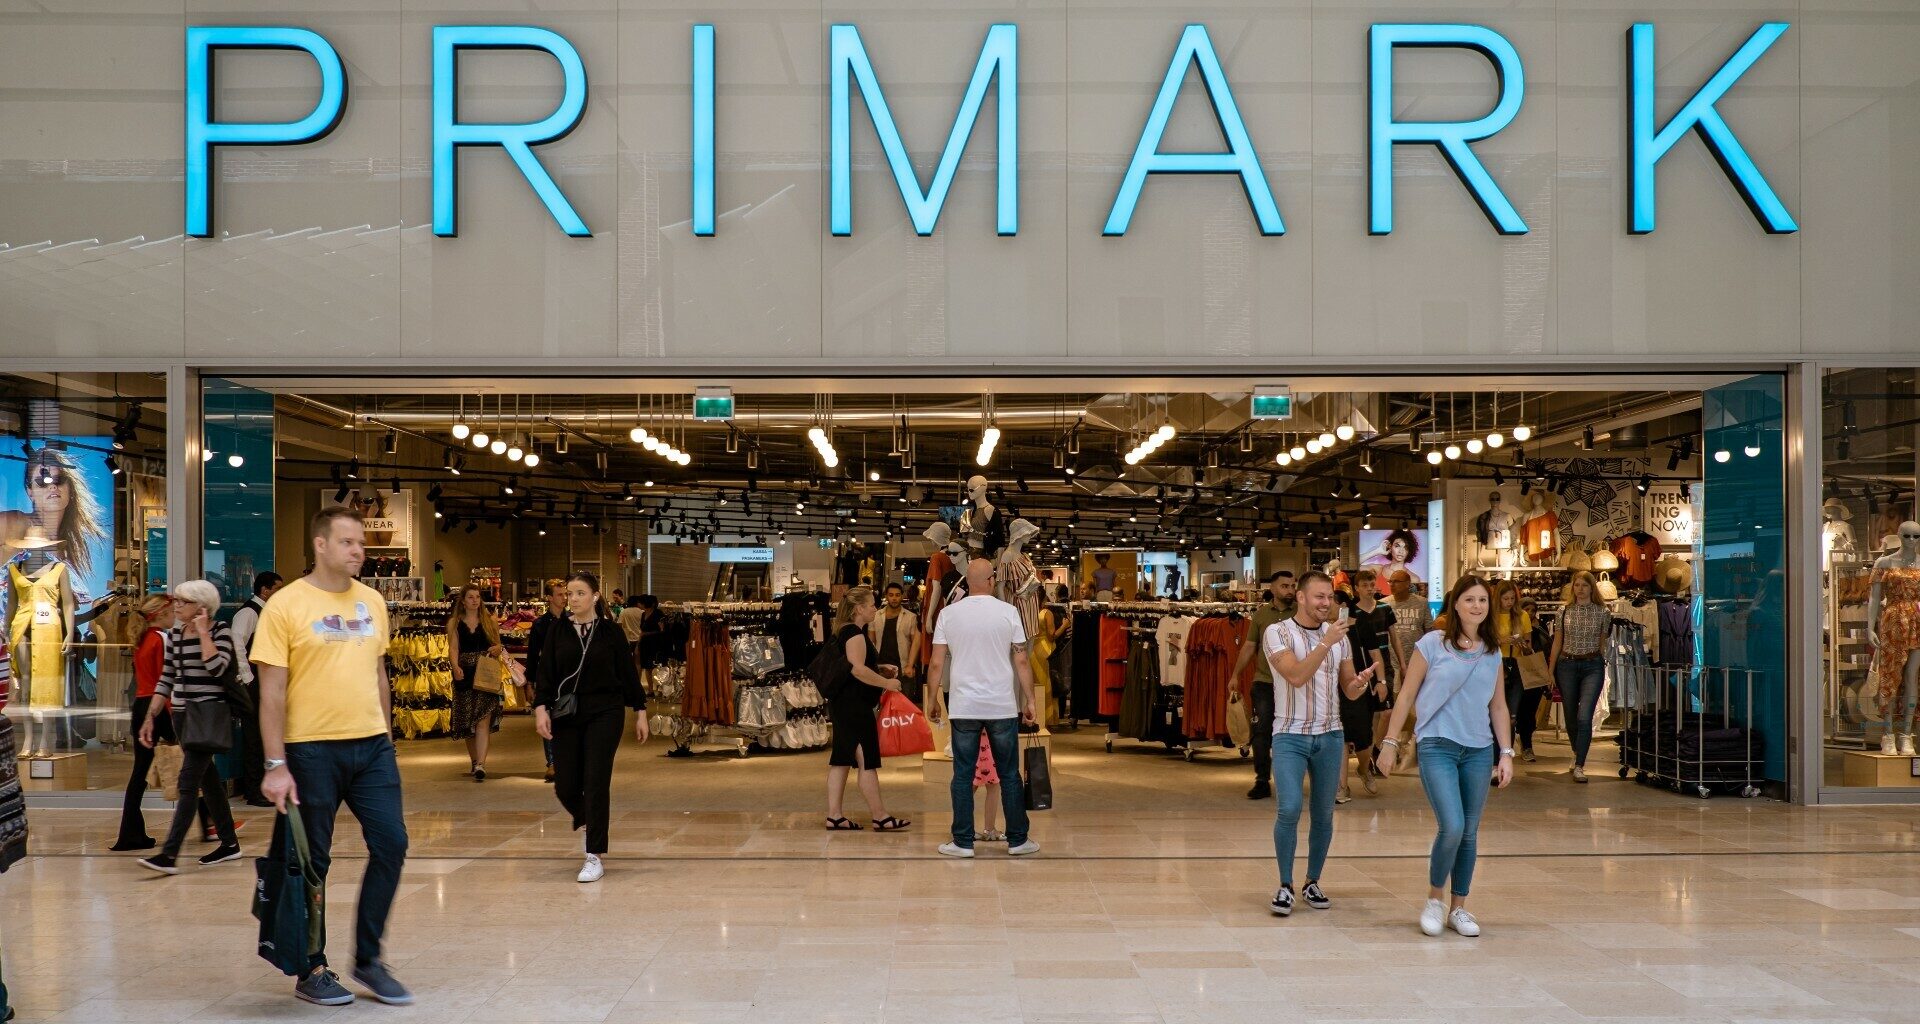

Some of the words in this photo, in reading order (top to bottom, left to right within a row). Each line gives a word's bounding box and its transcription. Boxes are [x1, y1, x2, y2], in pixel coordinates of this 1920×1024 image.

[185, 23, 1798, 238] PRIMARK
[1650, 506, 1680, 518] ING
[1651, 520, 1688, 532] NOW
[881, 712, 915, 728] ONLY
